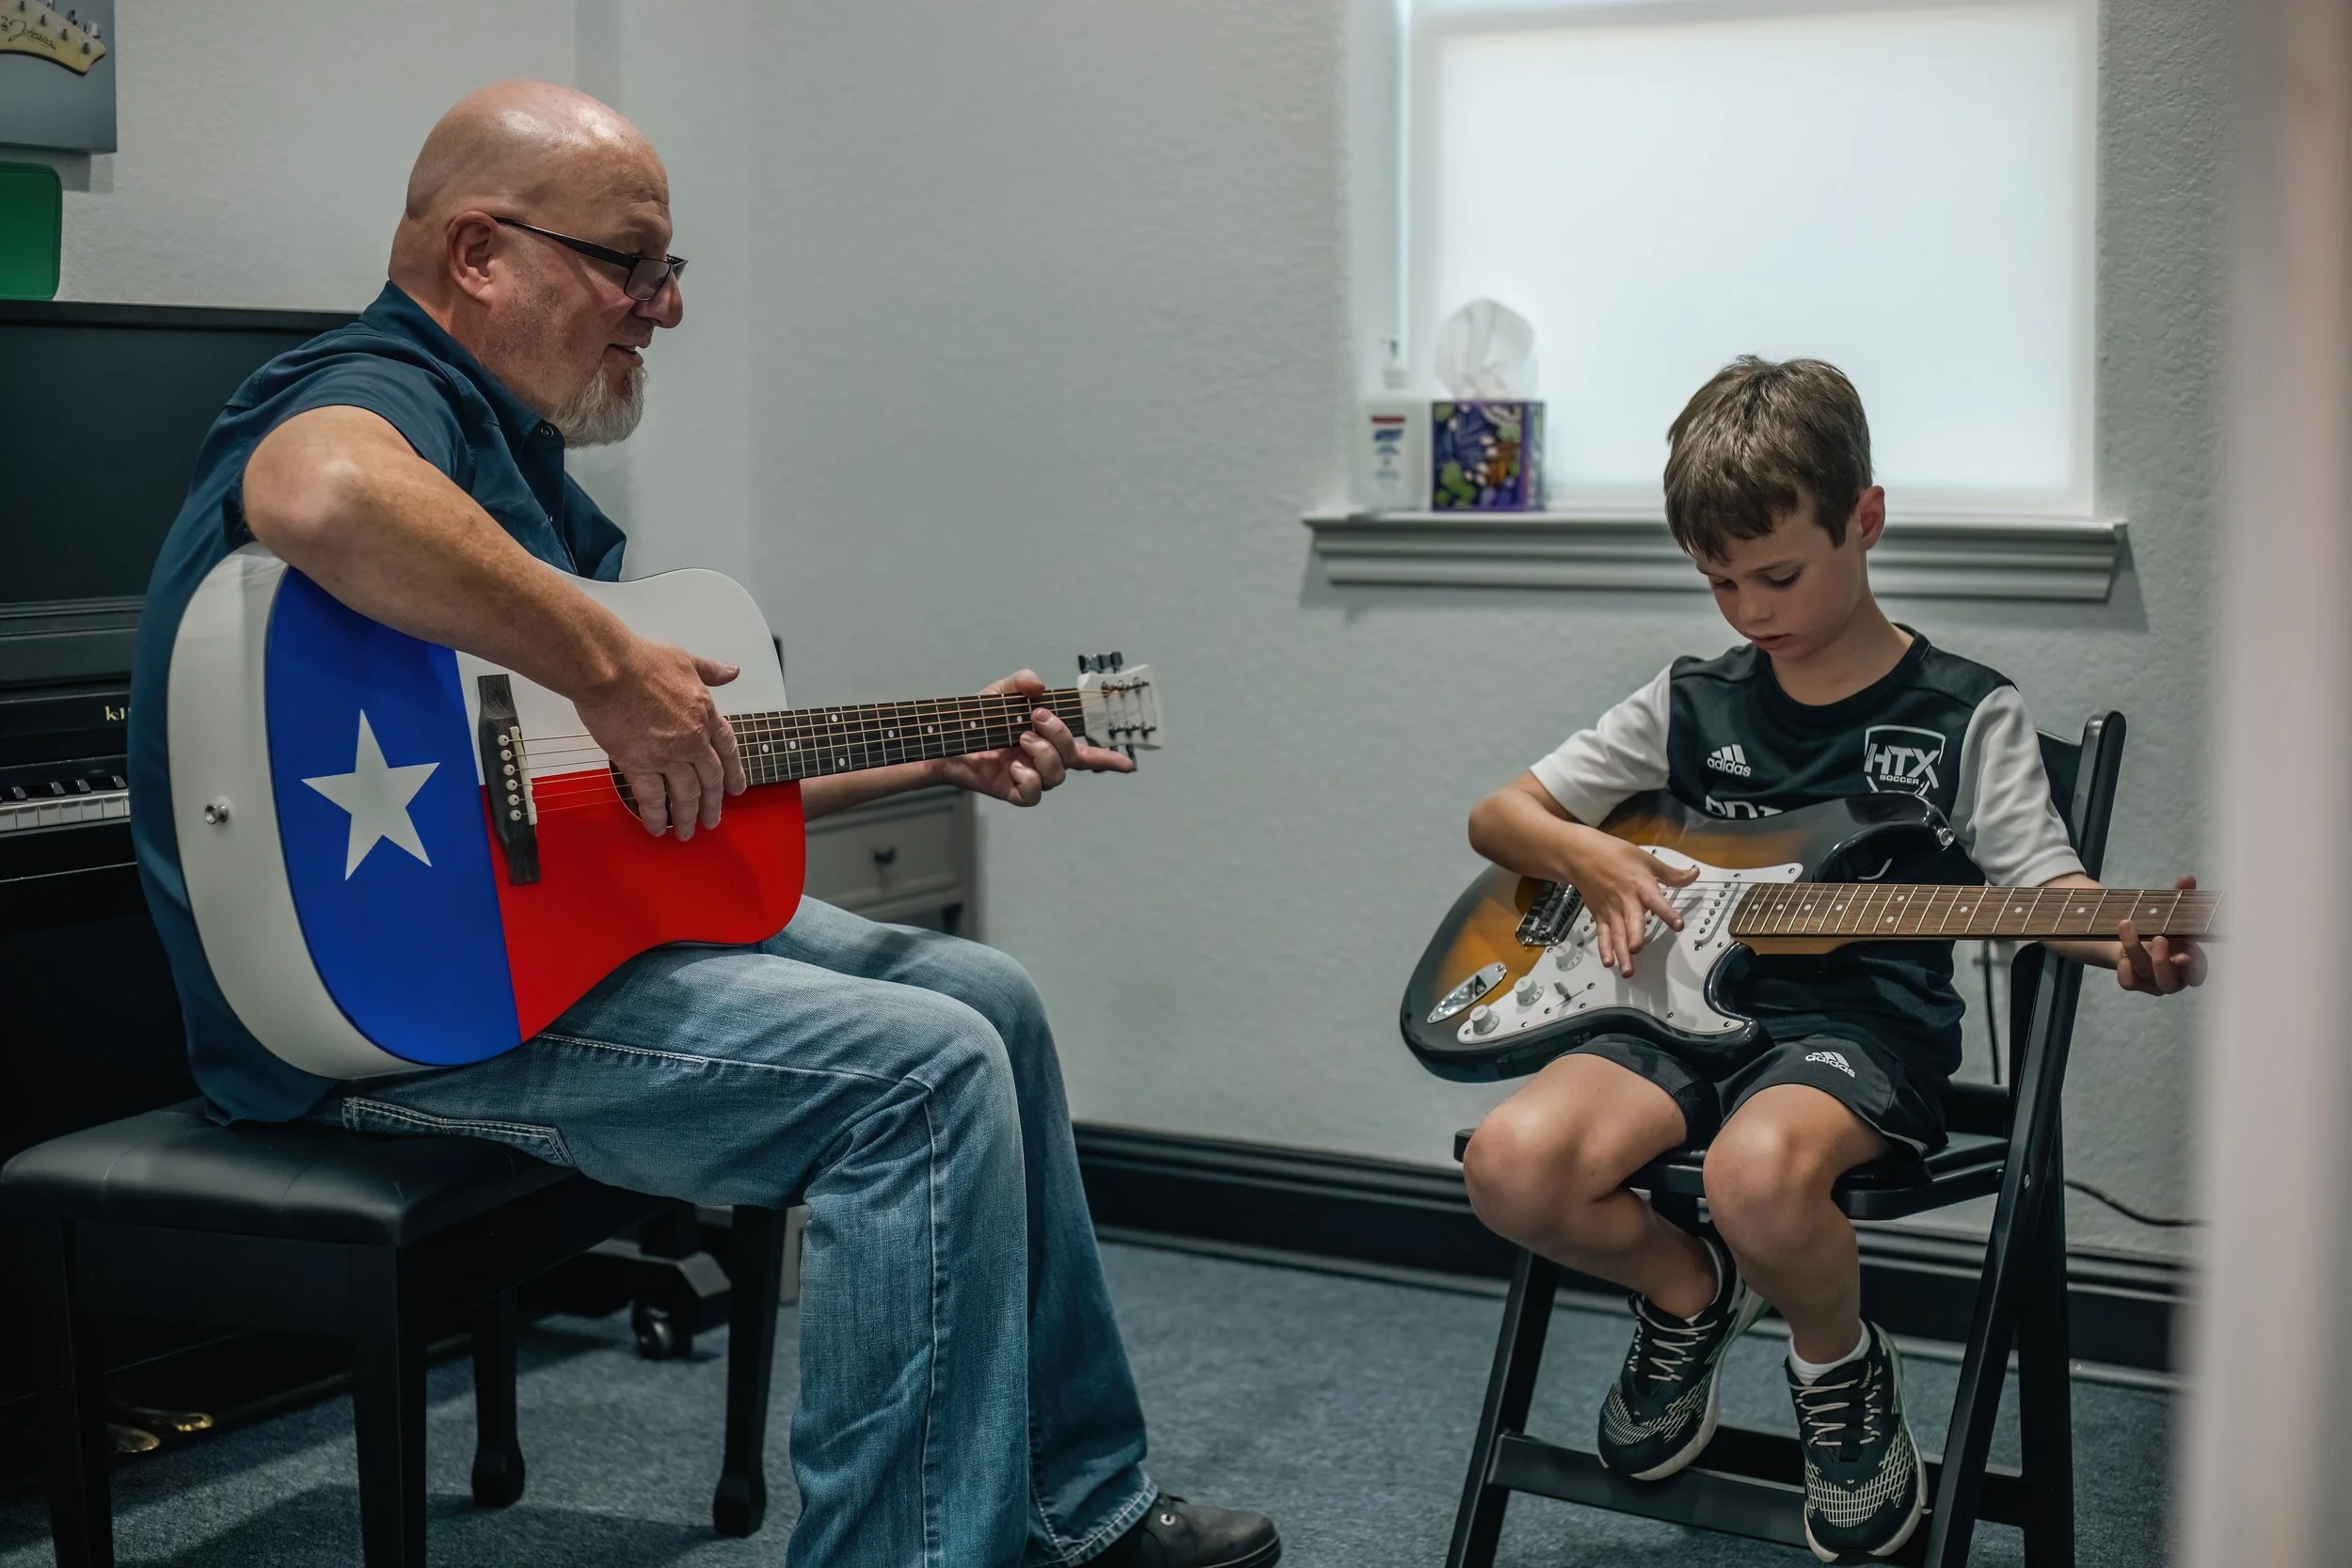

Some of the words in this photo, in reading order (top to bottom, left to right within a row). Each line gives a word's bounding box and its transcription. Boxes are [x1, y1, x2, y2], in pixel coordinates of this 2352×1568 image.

[1707, 757, 1752, 778] adidas
[1864, 743, 1940, 789] HTX
[1880, 774, 1919, 785] SOCCER
[1805, 1053, 1855, 1078] adidas
